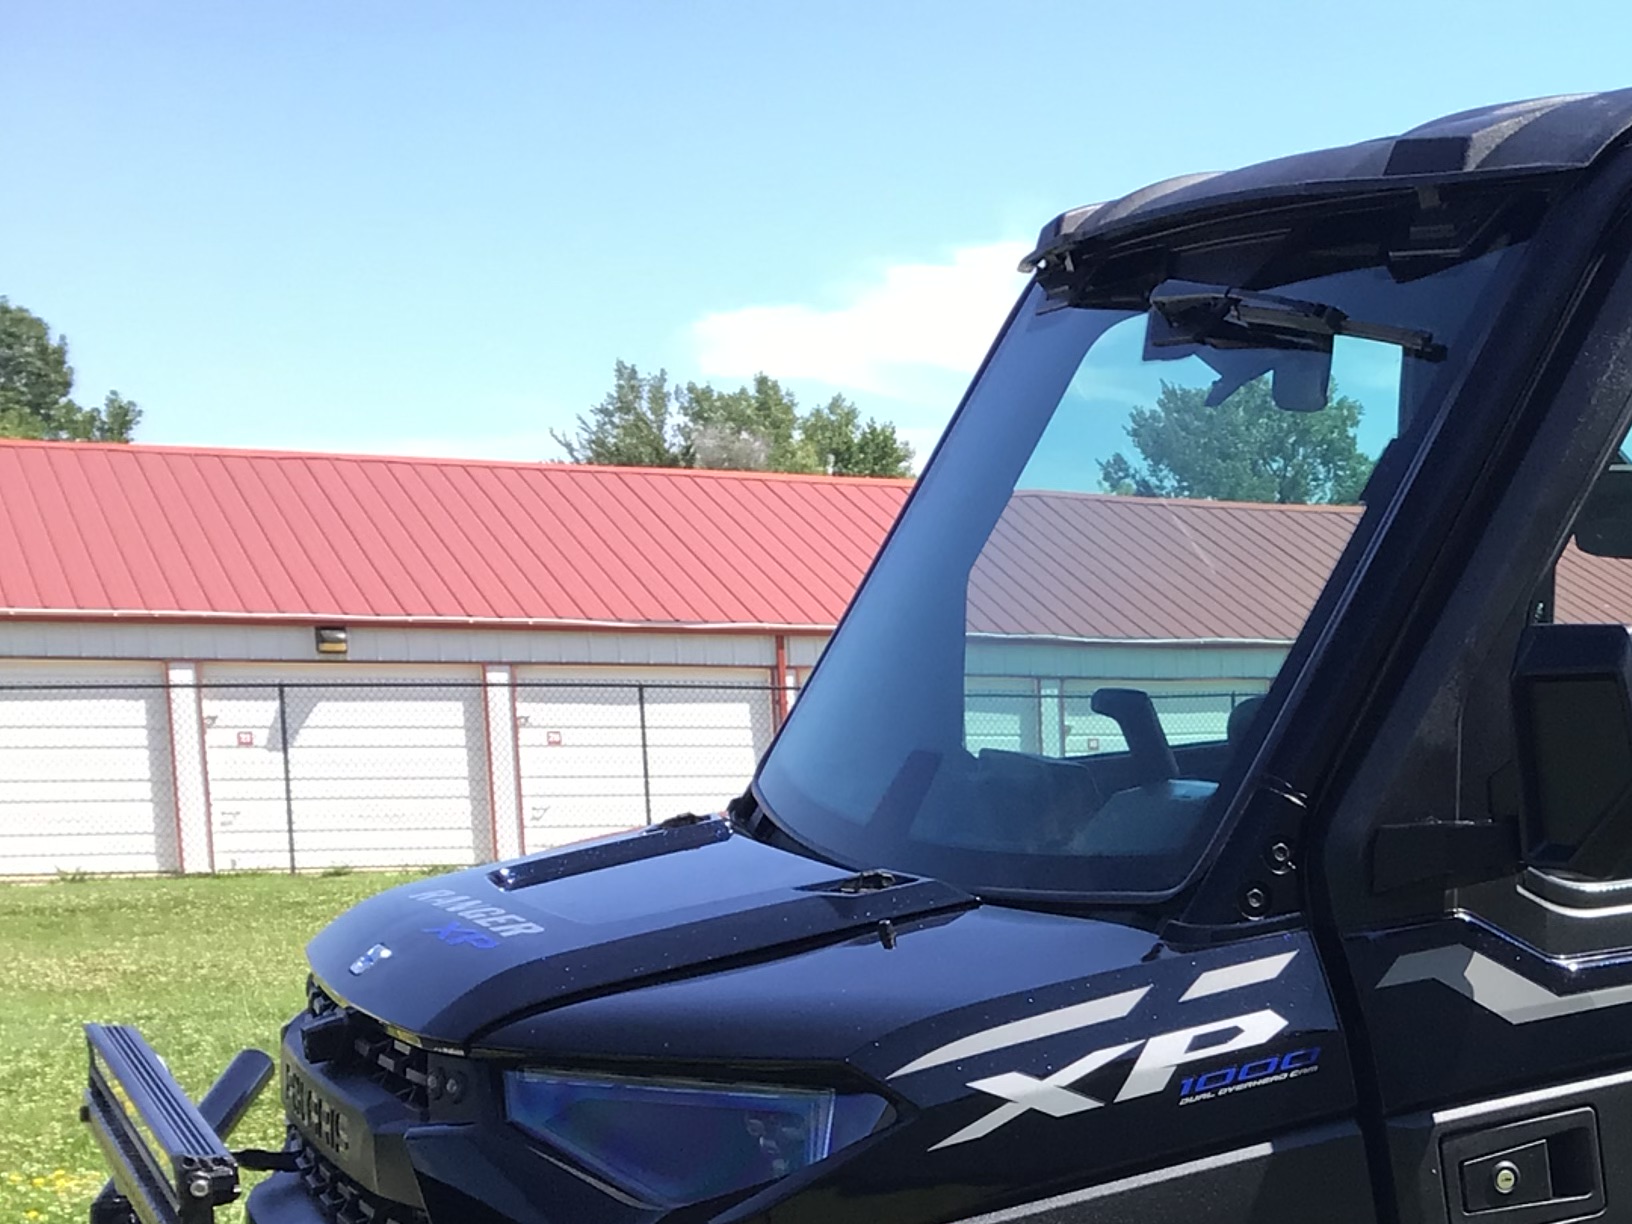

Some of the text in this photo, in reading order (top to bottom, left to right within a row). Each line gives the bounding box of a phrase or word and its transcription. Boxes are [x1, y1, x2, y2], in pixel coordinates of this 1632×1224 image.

[408, 889, 545, 938] RANGER
[421, 920, 498, 949] XP
[926, 1008, 1290, 1152] XP
[1178, 1089, 1217, 1106] DUAL
[1217, 1071, 1288, 1096] OVERHEAD
[1179, 1046, 1321, 1096] 1000
